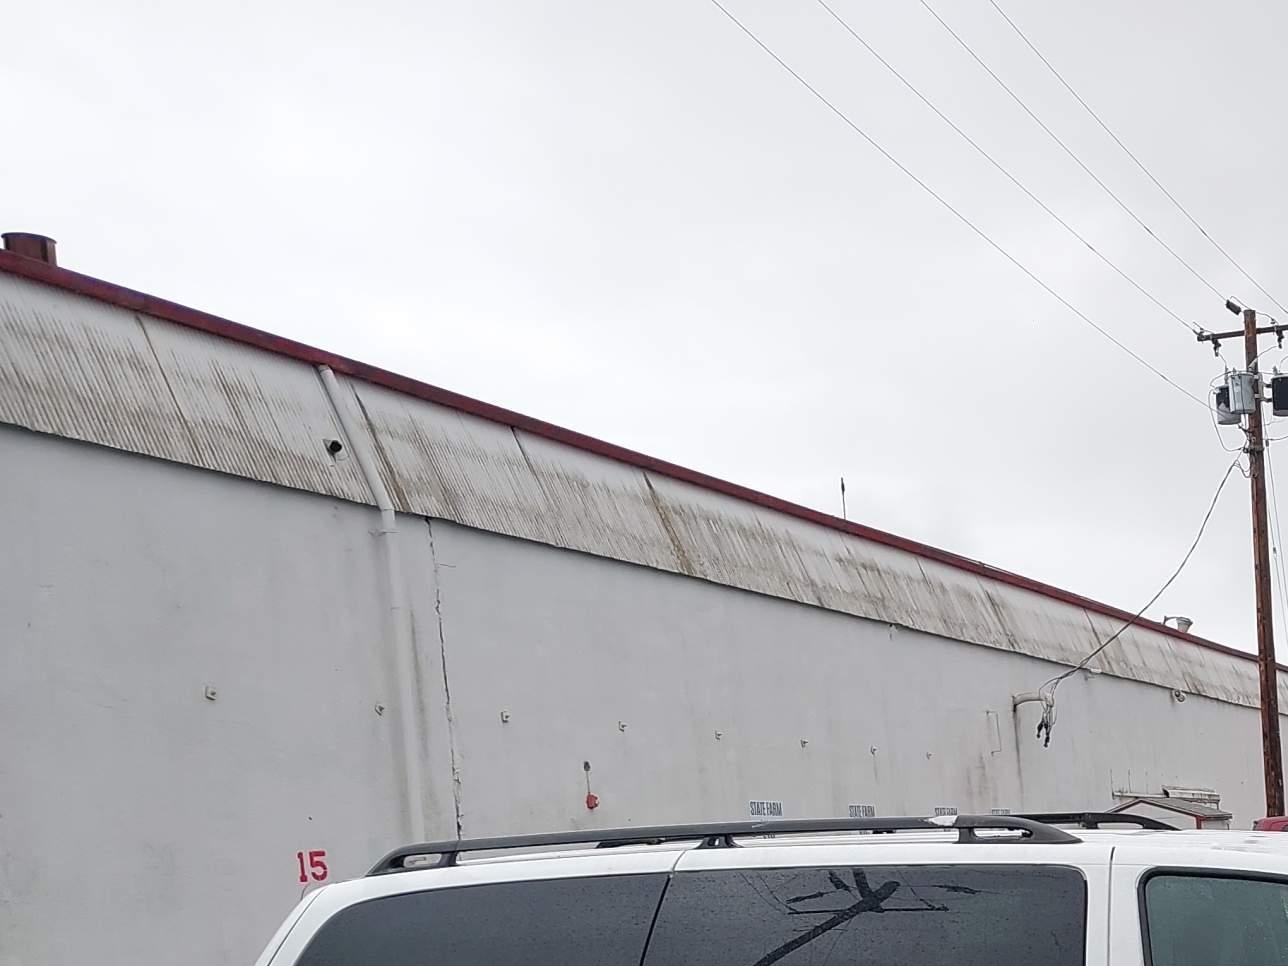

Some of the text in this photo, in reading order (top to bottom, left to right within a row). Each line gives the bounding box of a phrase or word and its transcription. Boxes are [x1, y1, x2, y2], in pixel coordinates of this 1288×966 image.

[749, 801, 783, 816] STATE FARM
[297, 850, 328, 883] 15
